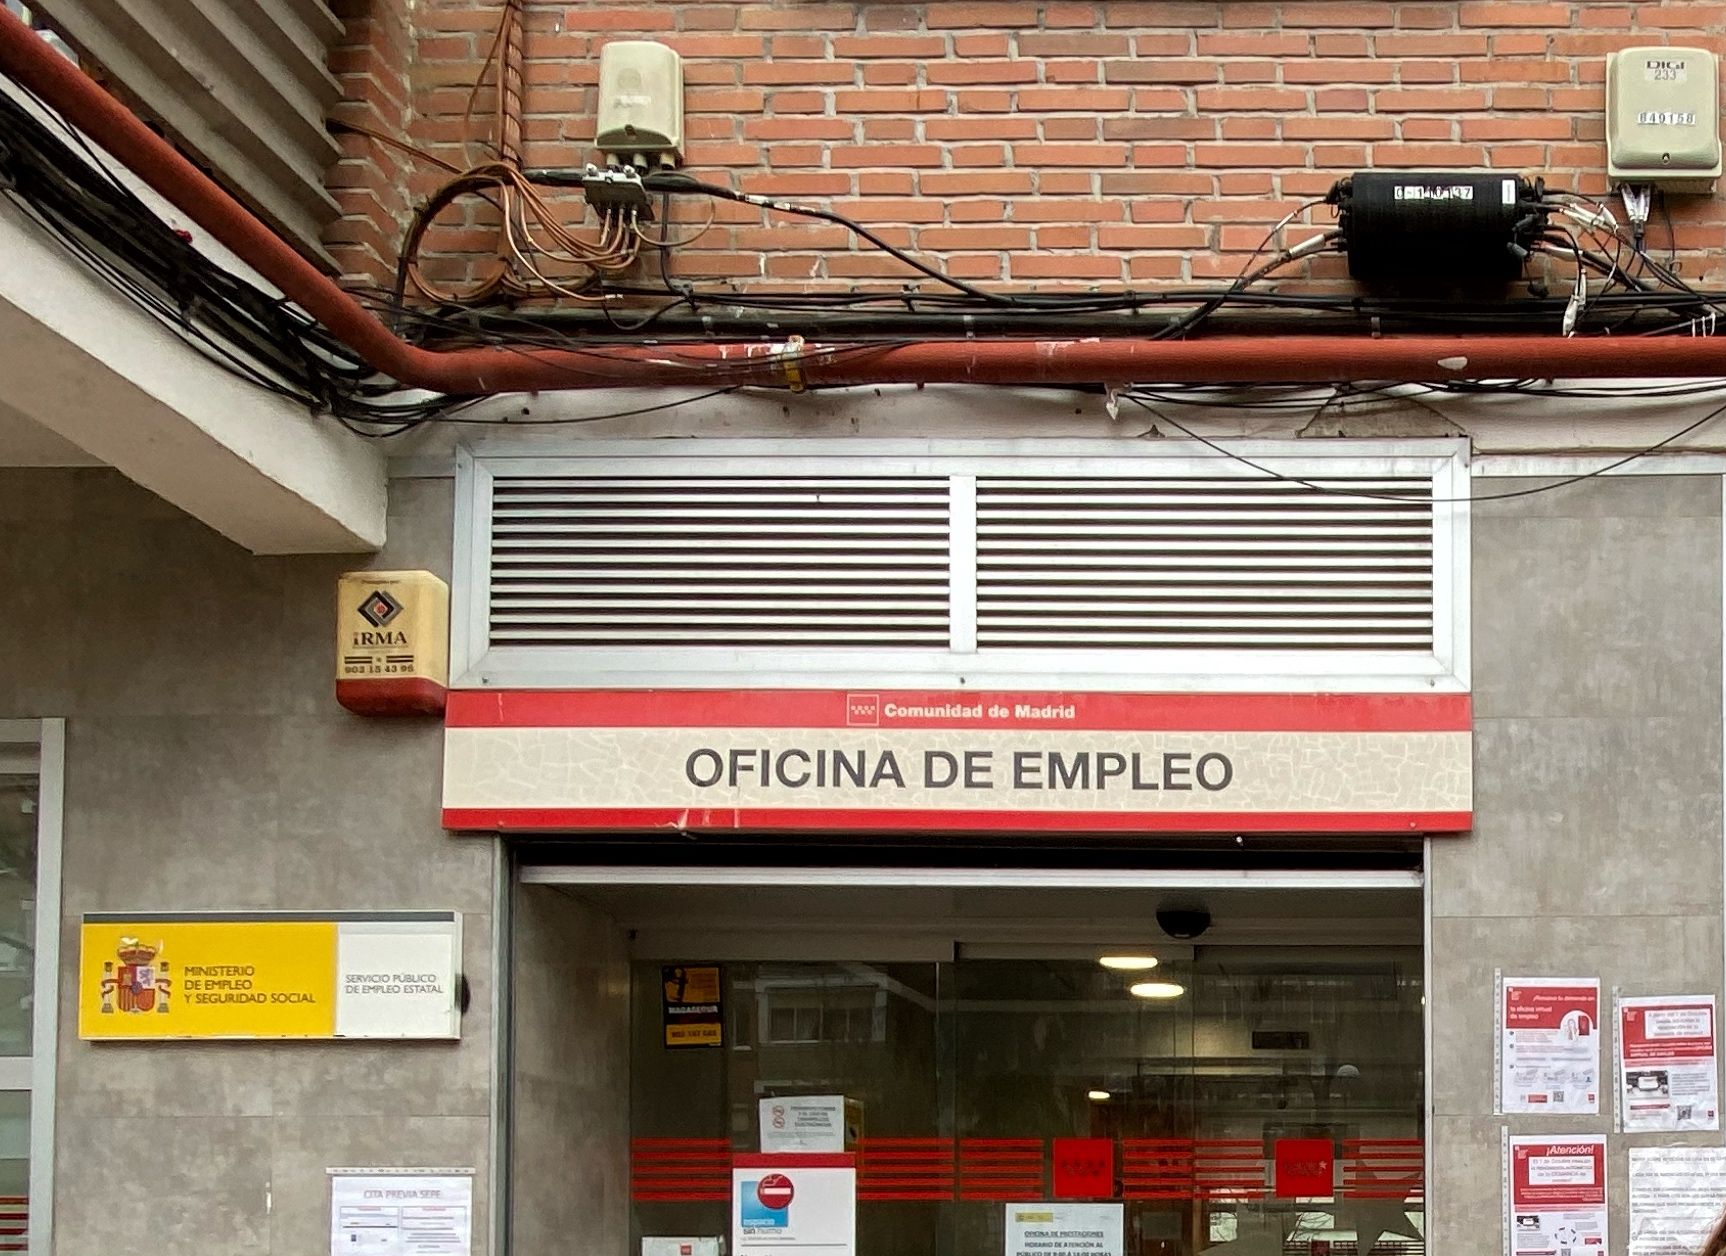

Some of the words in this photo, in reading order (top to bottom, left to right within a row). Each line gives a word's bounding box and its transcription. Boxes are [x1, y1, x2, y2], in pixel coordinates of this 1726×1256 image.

[1647, 60, 1685, 69] DIGI
[1654, 69, 1677, 81] 233
[384, 665, 398, 673] 43
[884, 703, 984, 719] Comunidad
[988, 704, 1009, 719] de
[1015, 704, 1075, 720] Madrid
[686, 748, 907, 789] OFICINA
[924, 750, 994, 790] DE
[1013, 751, 1234, 791] EMPLEO
[184, 966, 255, 977] MINISTERIO
[345, 974, 389, 984] SERVICIO
[392, 972, 437, 984] PÚBLICO
[184, 980, 201, 990] DE
[205, 980, 252, 991] EMPLEO
[345, 984, 359, 994] DE
[361, 984, 400, 994] EMPLEO
[403, 984, 444, 994] ESTATAL
[184, 993, 191, 1004] Y
[195, 993, 267, 1004] SEGURIDAD
[271, 993, 317, 1004] SOCIAL
[1546, 1145, 1595, 1156] ¡Atención!
